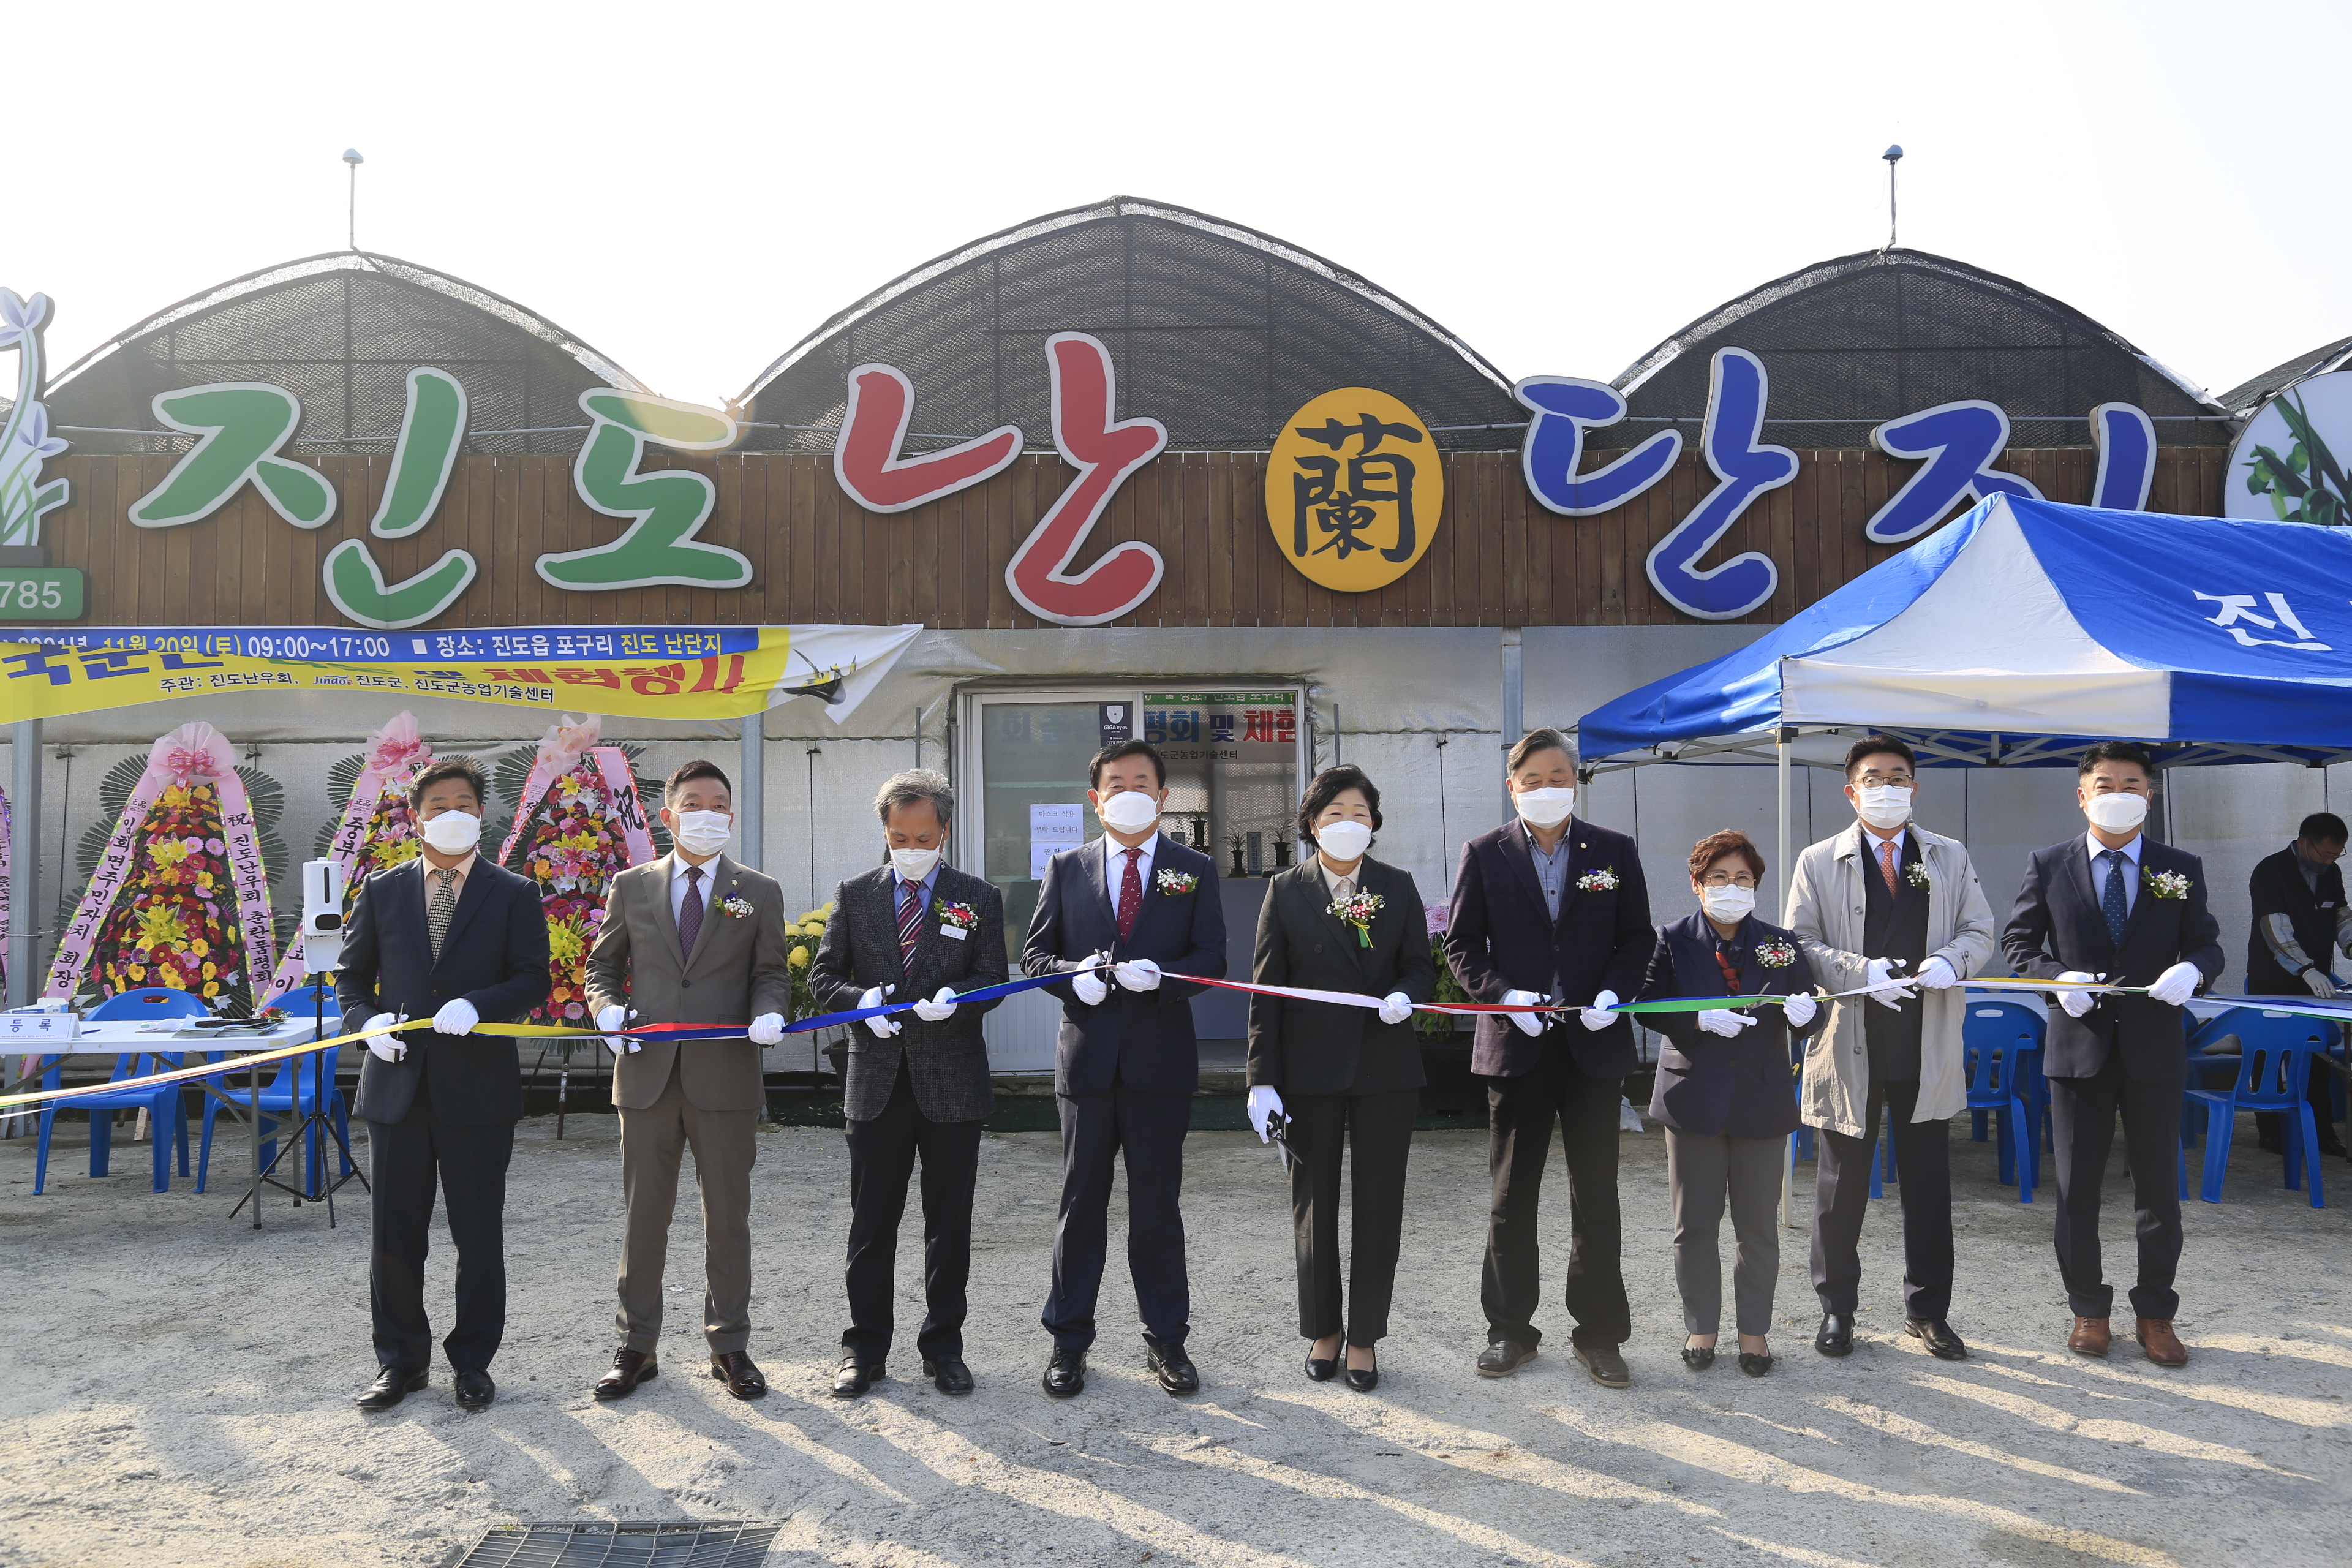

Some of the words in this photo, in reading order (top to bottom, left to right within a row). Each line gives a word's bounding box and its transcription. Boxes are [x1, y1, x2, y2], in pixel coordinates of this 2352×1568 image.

[127, 366, 753, 629] 진도
[1293, 413, 1422, 562] 蘭
[0, 580, 61, 609] 785
[154, 635, 198, 652] 20일
[206, 634, 241, 655] (토)
[248, 636, 390, 658] 09:00~17:00
[437, 636, 484, 658] 장소:
[492, 635, 549, 657] 진도읍
[557, 635, 613, 656] 포구리
[621, 633, 658, 655] 진도
[663, 633, 722, 655] 난단지
[160, 676, 202, 693] 주관:
[210, 672, 298, 687] 진도난우회,
[356, 676, 409, 689] 진도군,
[414, 679, 554, 703] 진도군농업기술센터
[1210, 715, 1234, 742] 및
[227, 813, 251, 826] 祝
[614, 785, 645, 833] 祝
[232, 834, 262, 903] 진도난우회
[246, 911, 273, 982] 춘란품평회
[53, 950, 80, 988] 회장
